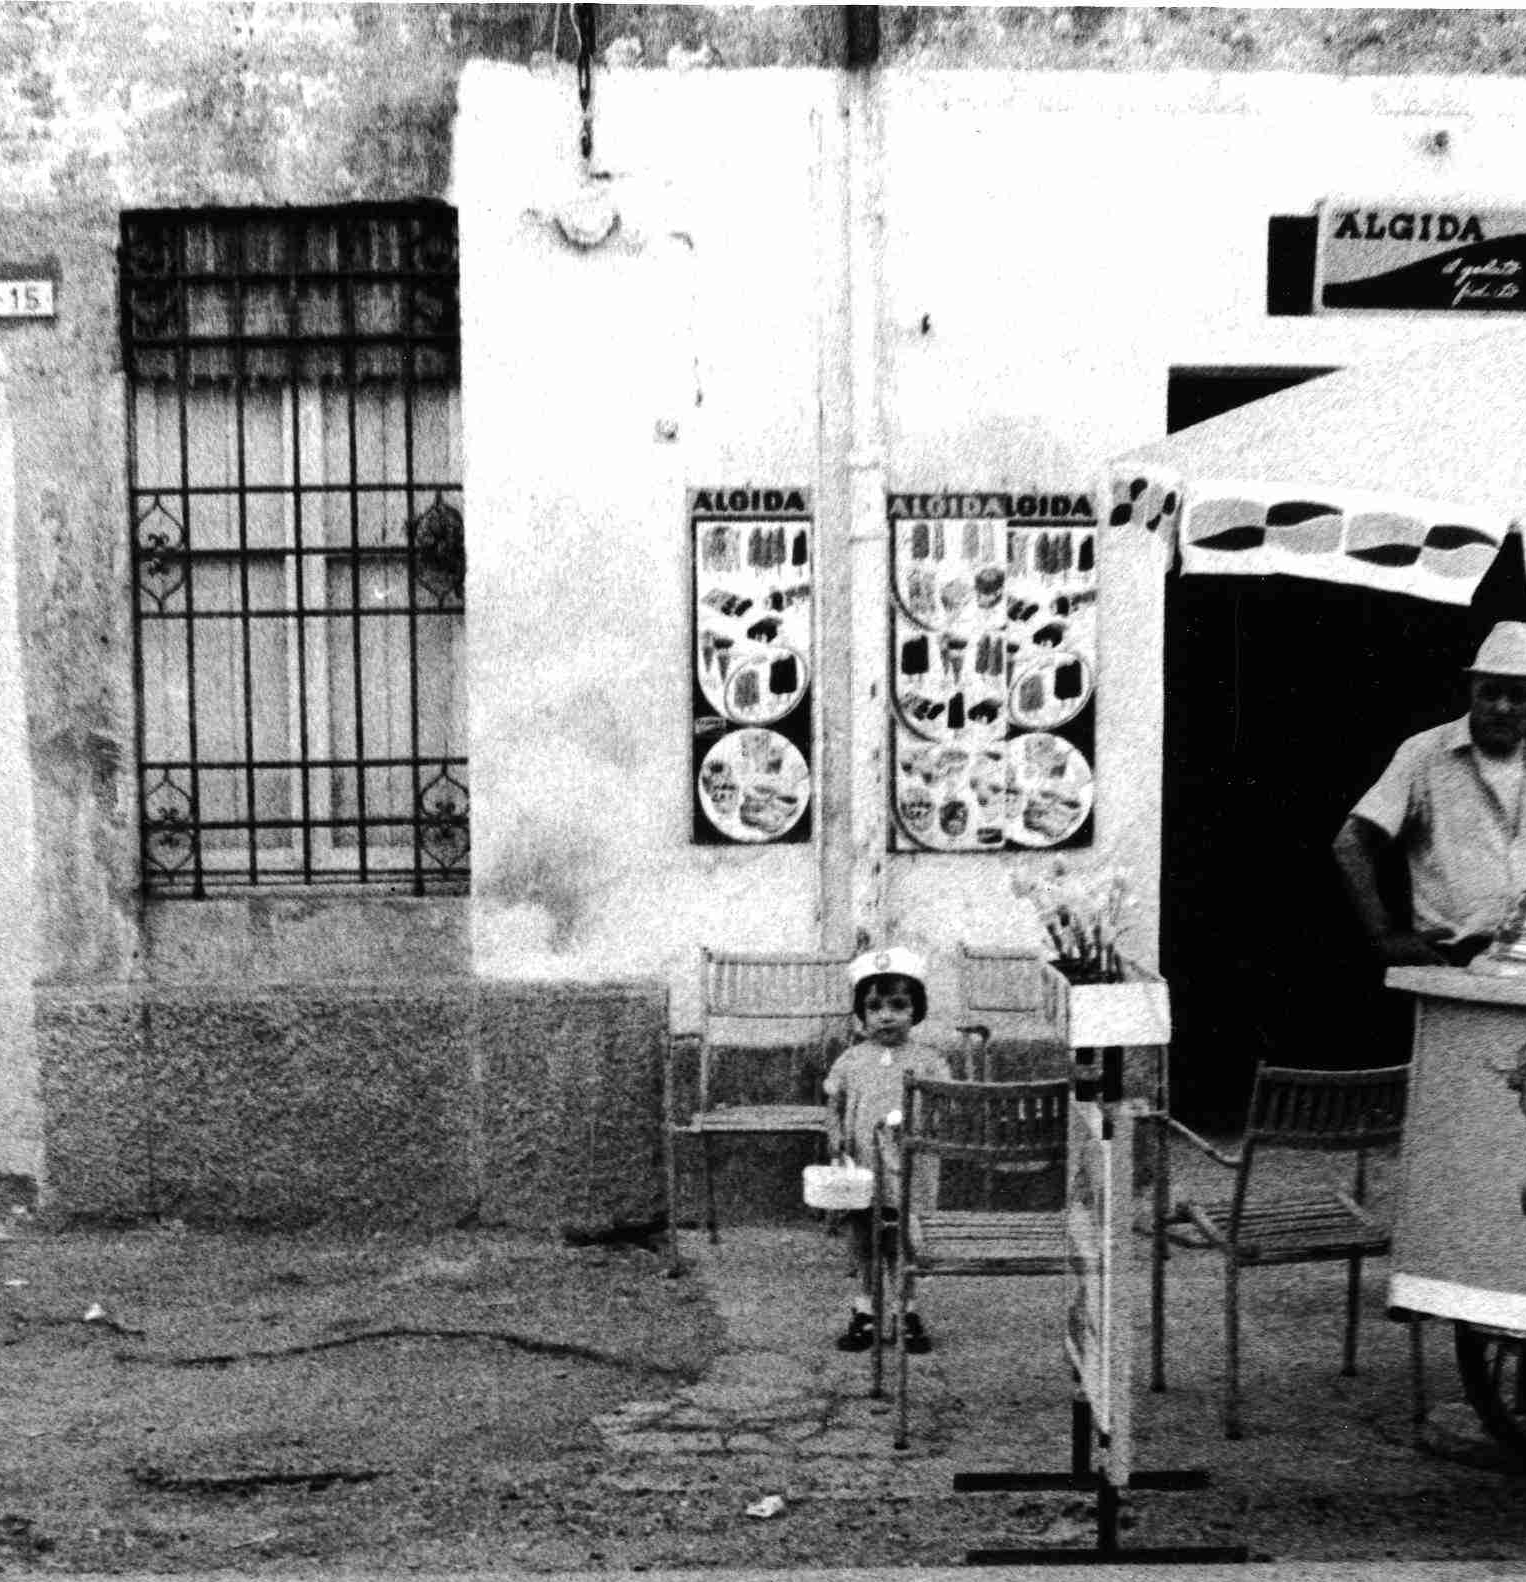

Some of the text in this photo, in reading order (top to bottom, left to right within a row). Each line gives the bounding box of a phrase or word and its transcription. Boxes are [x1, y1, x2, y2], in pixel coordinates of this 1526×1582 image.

[1333, 211, 1485, 243] ALGIDA
[10, 287, 40, 310] 15
[692, 489, 805, 512] ALGIDA
[889, 496, 1005, 517] ALGIDA
[1007, 494, 1093, 517] LGIDA
